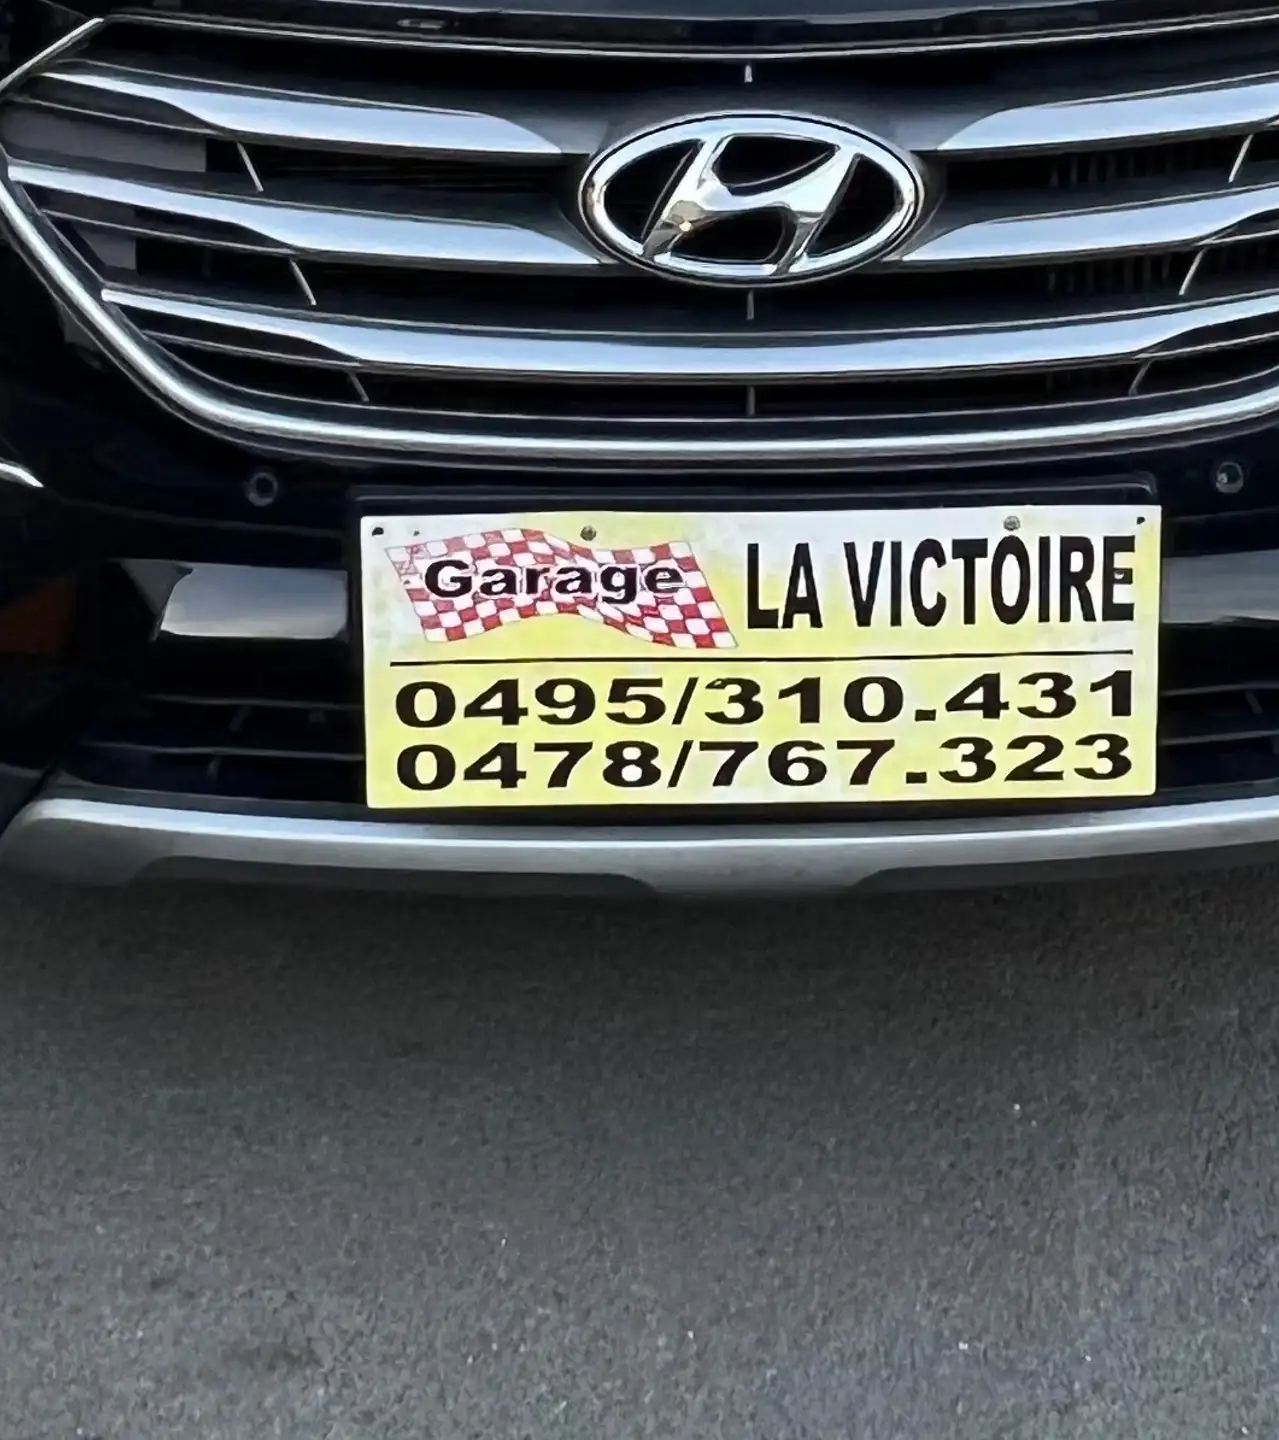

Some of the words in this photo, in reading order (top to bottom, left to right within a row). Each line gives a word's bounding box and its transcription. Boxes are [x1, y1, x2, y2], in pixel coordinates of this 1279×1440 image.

[423, 558, 685, 605] Garage
[746, 541, 824, 630] LA
[843, 534, 1137, 628] VICTOIRE
[395, 669, 1133, 729] 0495/310.431
[396, 732, 1133, 792] 0478/767.323
